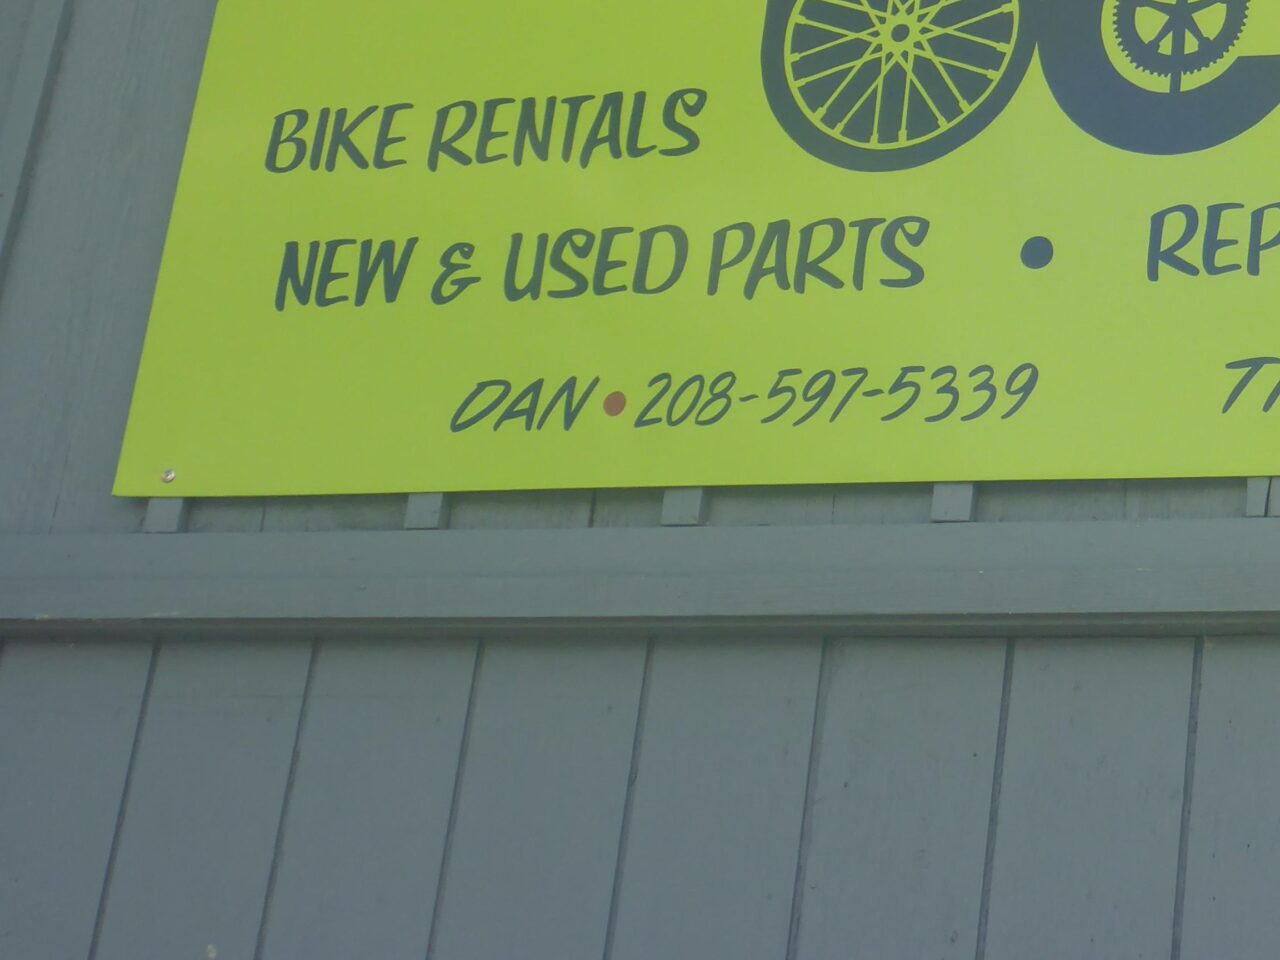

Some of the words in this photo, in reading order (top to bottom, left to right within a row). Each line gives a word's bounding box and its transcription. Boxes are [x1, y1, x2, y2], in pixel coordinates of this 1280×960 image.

[265, 103, 413, 173] BIKE
[428, 88, 707, 172] RENTALS
[275, 237, 418, 311] NEW
[431, 243, 480, 305] &
[504, 225, 688, 301] USED
[708, 216, 929, 300] PARTS
[451, 376, 599, 432] DAN
[634, 363, 1038, 428] 208-597-5339
